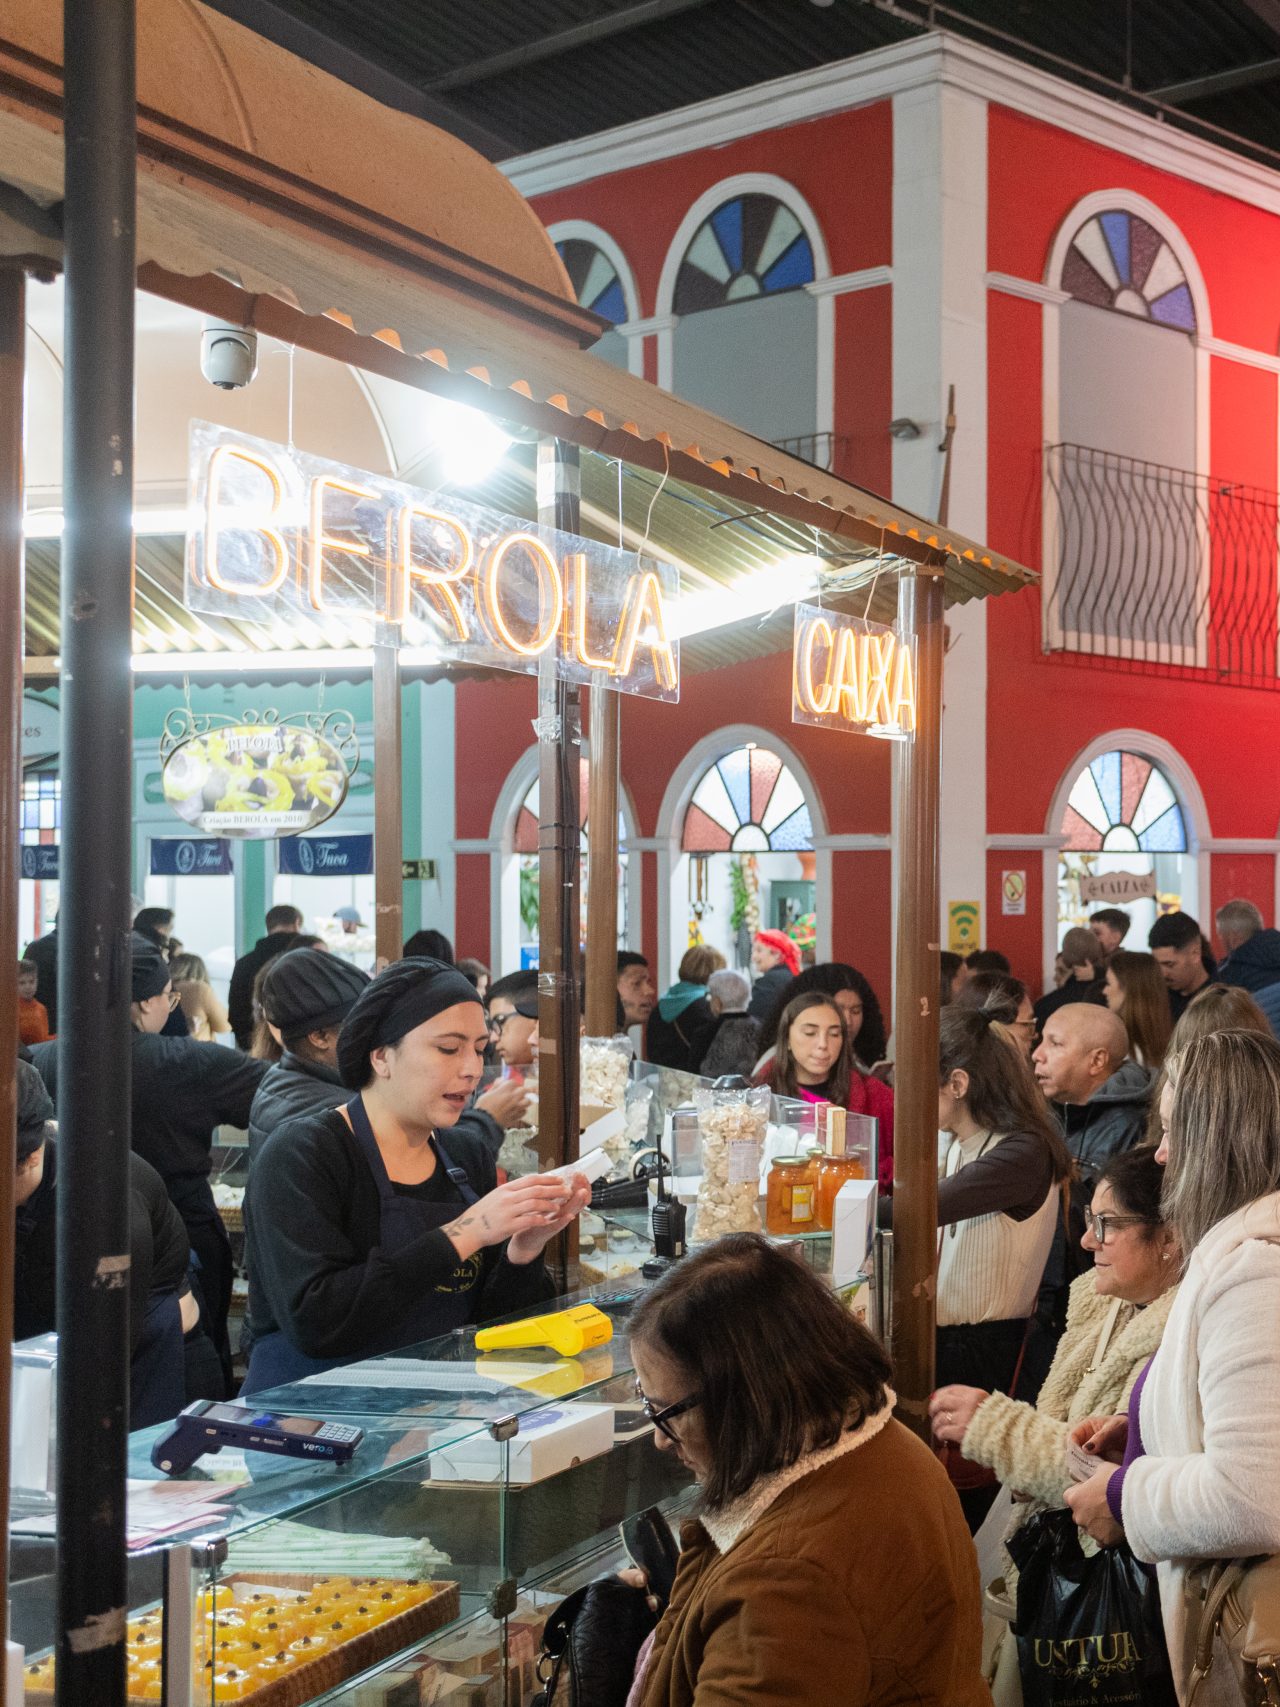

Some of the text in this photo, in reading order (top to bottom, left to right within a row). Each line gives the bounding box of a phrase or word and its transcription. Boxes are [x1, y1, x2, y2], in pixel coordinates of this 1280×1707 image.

[203, 444, 680, 691] BEROLA
[800, 617, 917, 732] CAIXA
[203, 815, 232, 827] Criação
[233, 815, 268, 825] BEROLA
[302, 1441, 326, 1454] vero
